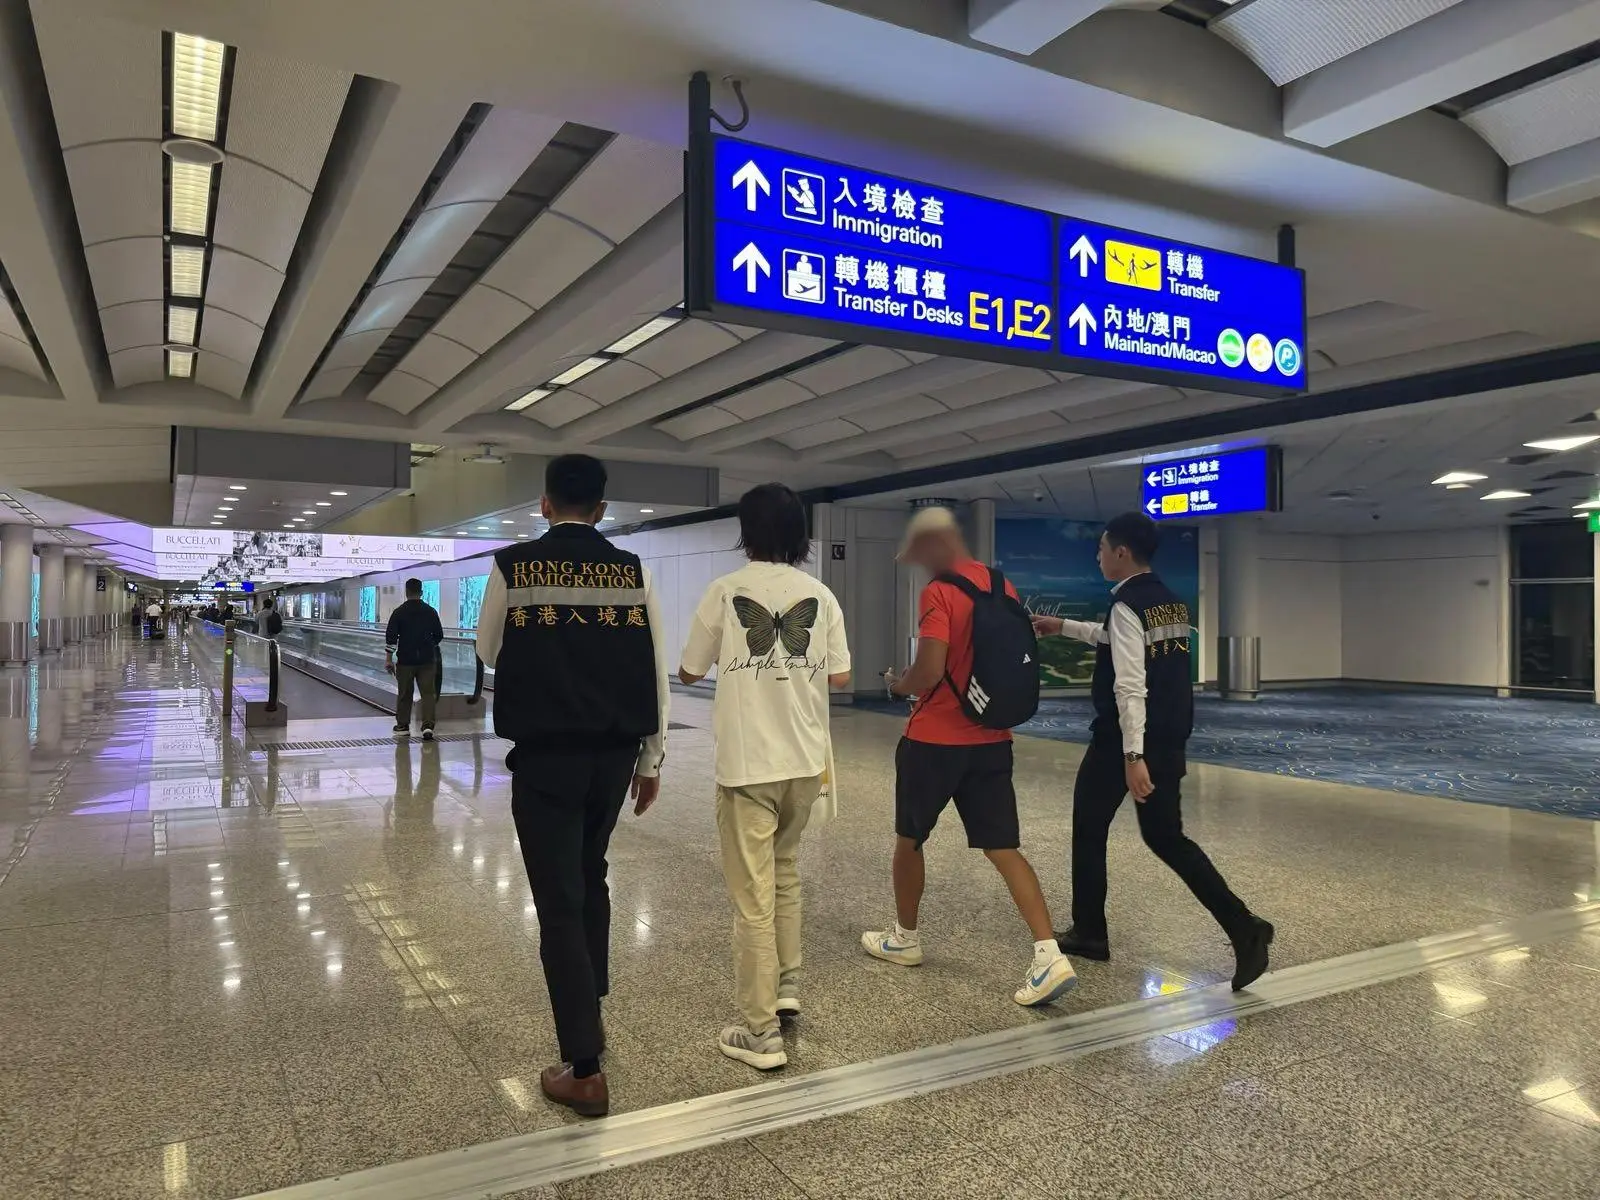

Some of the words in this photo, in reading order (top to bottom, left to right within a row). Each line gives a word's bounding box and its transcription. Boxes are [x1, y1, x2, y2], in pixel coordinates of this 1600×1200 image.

[833, 177, 945, 226] 入境檢查
[832, 209, 943, 249] Immigration
[1166, 249, 1204, 280] 轉機
[1167, 277, 1220, 303] Transfer
[833, 286, 908, 318] Transfer
[913, 300, 964, 327] Desks
[969, 291, 1051, 341] E1,E2
[1104, 332, 1217, 365] Mainland/Macao
[1178, 473, 1219, 485] Immigration
[1190, 502, 1218, 511] Transfer
[166, 535, 221, 545] BUCCELLATI
[397, 543, 445, 553] BUCCELLATI
[512, 560, 574, 575] HONG
[581, 562, 636, 577] KONG
[98, 581, 105, 590] 2
[512, 572, 637, 588] IMMIGRATION
[509, 605, 647, 628] 香港入境處
[1143, 604, 1172, 619] HONG
[723, 648, 780, 681] simple
